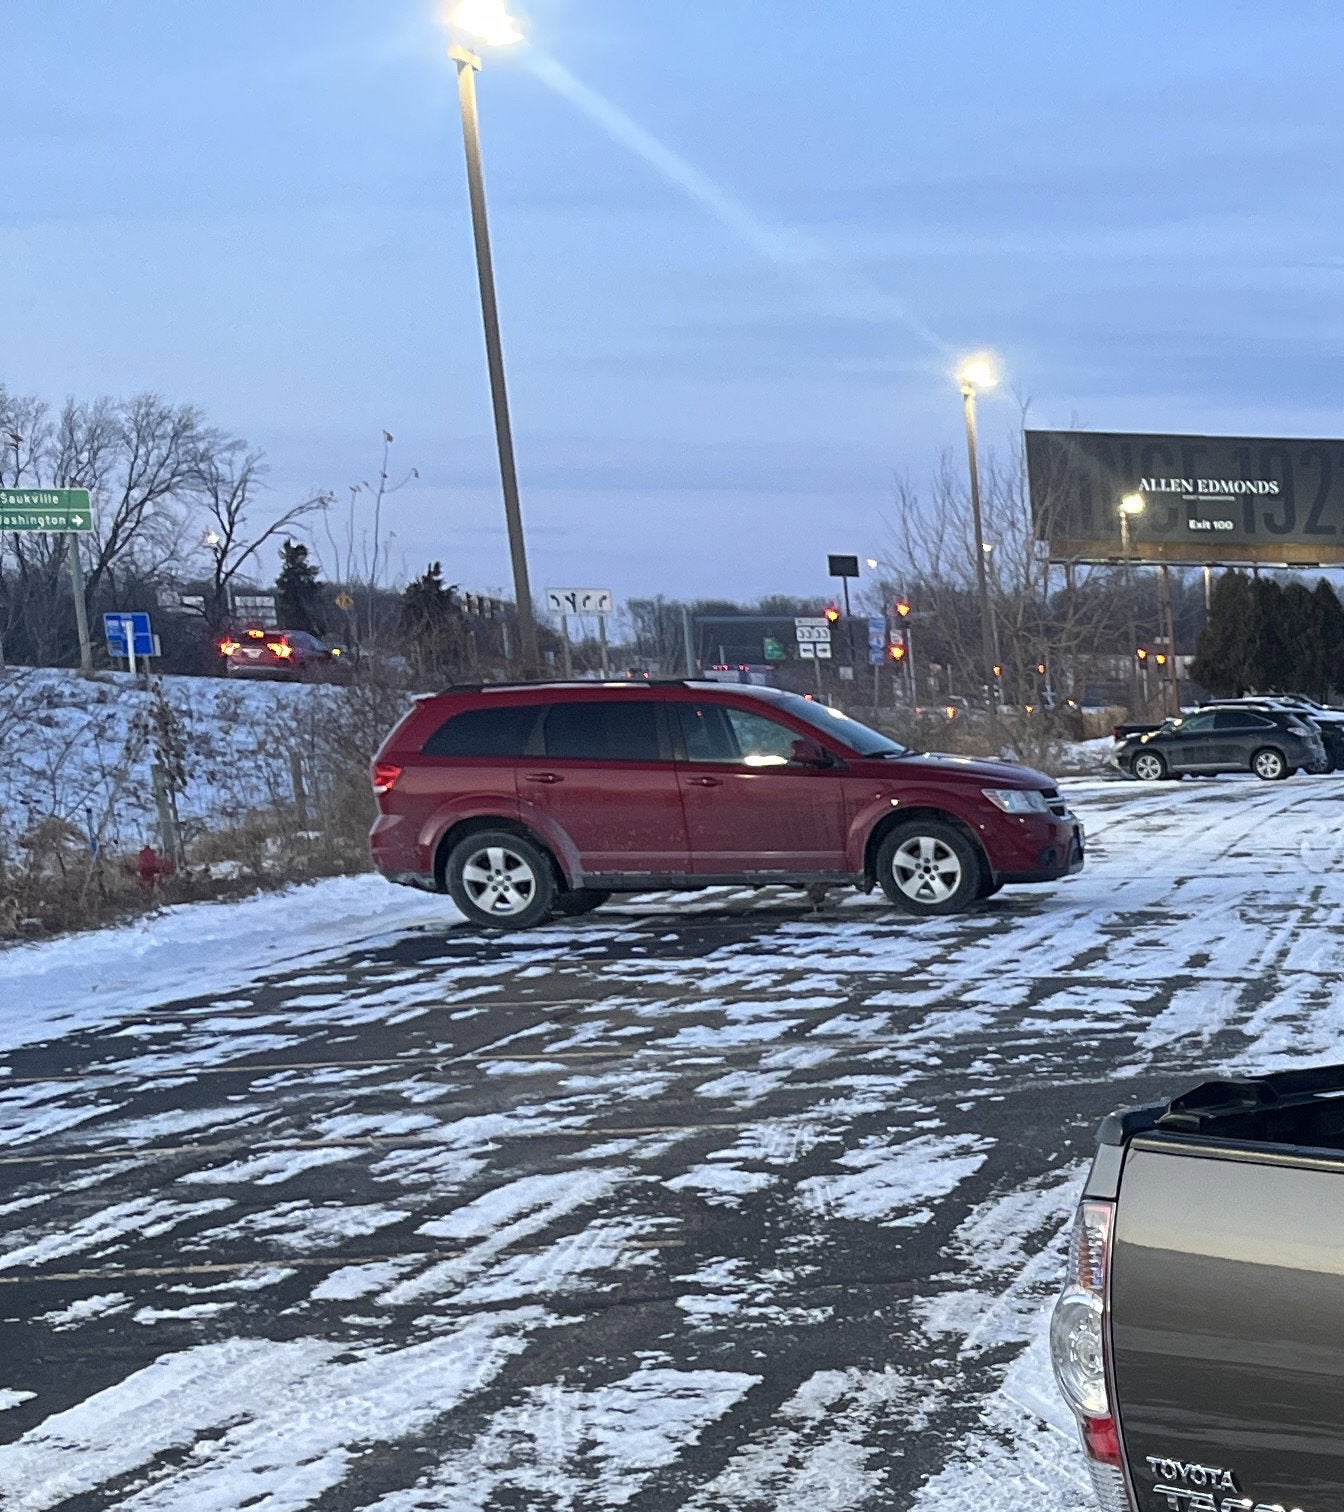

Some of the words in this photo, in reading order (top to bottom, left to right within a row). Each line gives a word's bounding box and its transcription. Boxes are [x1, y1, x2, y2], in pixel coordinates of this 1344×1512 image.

[1139, 478, 1193, 492] ALLEN
[1197, 479, 1280, 494] EDMONDS
[1189, 520, 1211, 530] Exit
[1213, 521, 1234, 530] 100
[1146, 1455, 1239, 1494] TOYOTA
